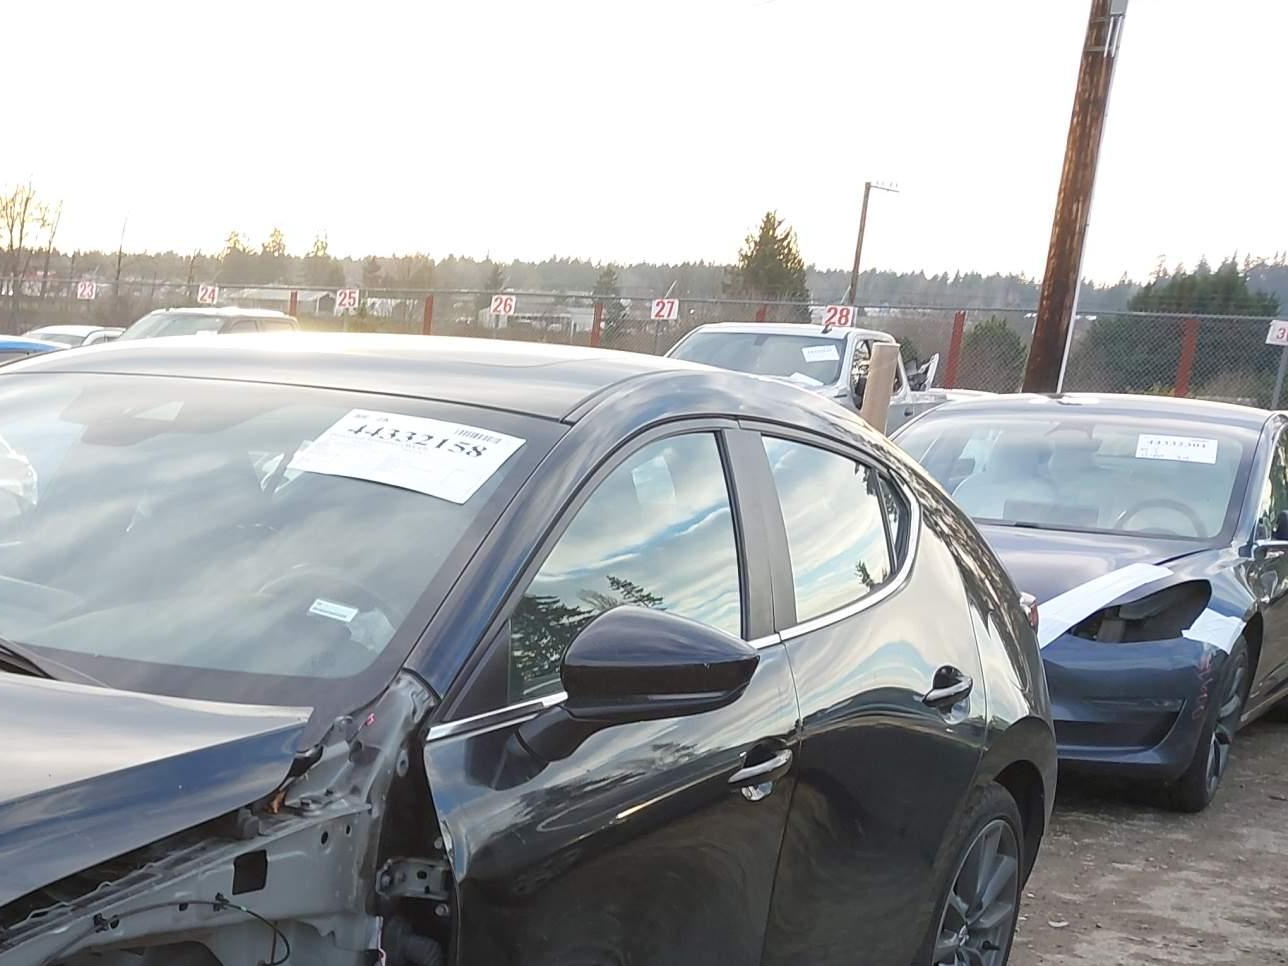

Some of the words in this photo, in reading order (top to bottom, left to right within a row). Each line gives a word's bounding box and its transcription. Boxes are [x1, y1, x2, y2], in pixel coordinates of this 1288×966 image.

[79, 281, 94, 298] 23
[200, 286, 216, 303] 24
[338, 289, 356, 307] 25
[493, 297, 513, 313] 26
[655, 300, 675, 318] 27
[825, 307, 850, 326] 28
[347, 424, 487, 457] 44332158
